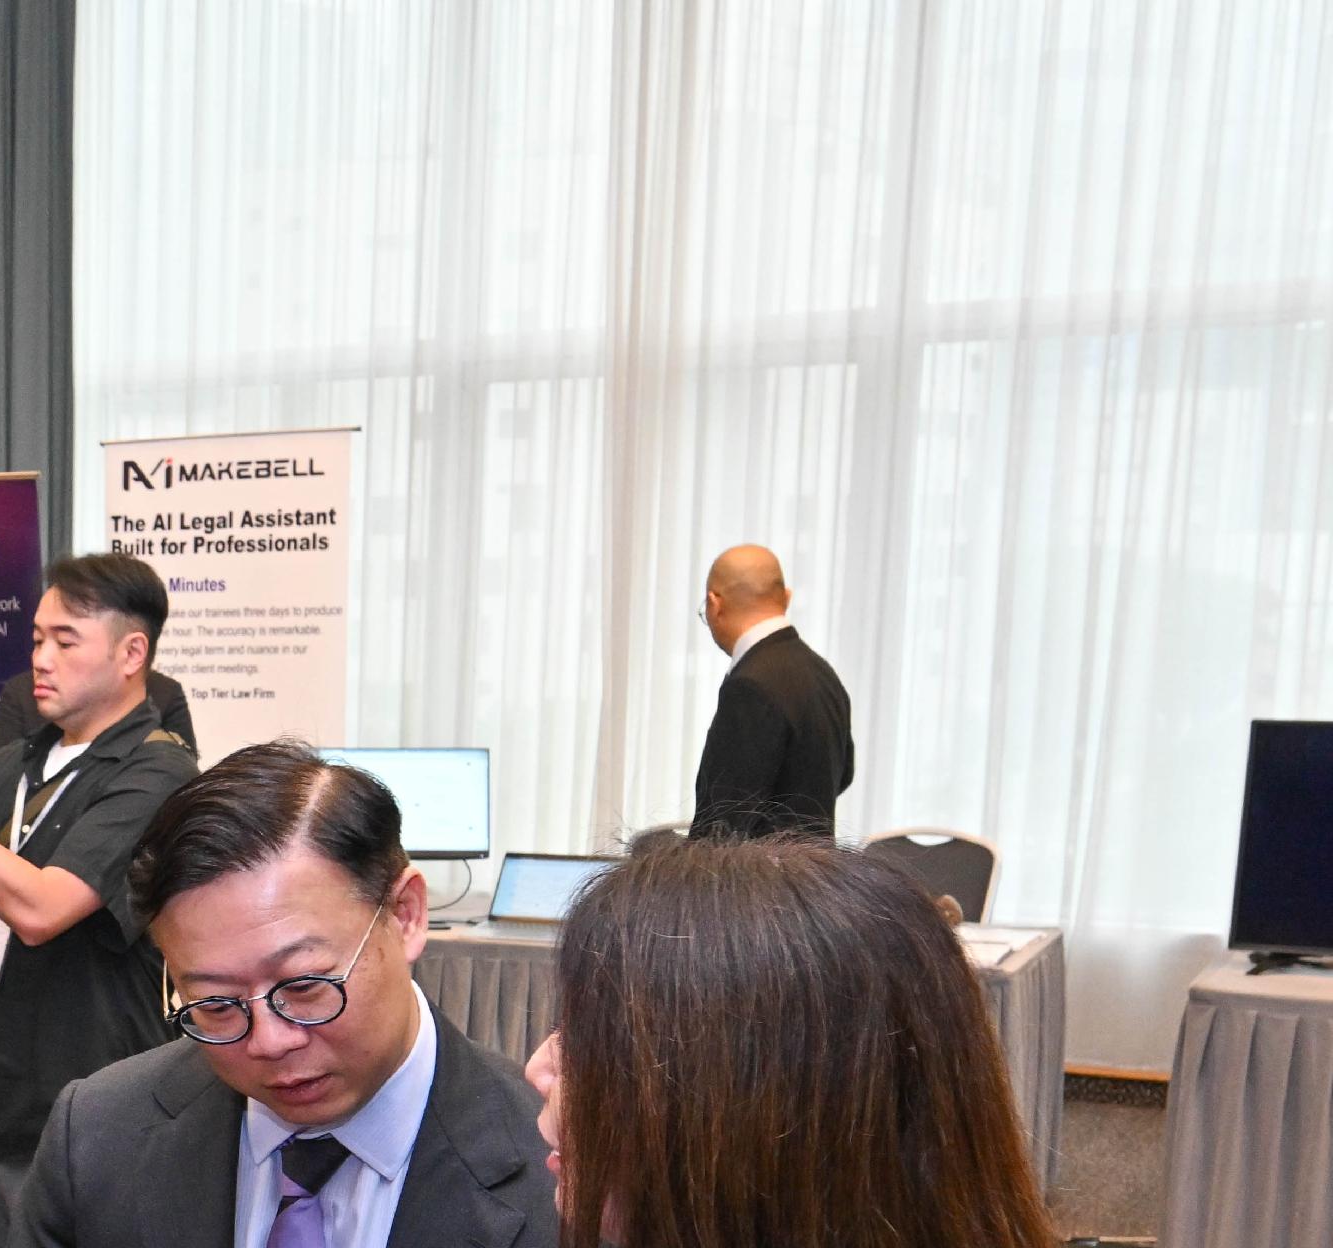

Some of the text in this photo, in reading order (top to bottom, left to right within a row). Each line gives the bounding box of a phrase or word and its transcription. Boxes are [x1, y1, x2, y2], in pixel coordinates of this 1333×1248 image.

[179, 458, 325, 482] MAKEBELL
[111, 508, 337, 534] The AI Legal Assistant
[112, 533, 329, 556] Built for Professionals
[168, 577, 226, 592] Minutes
[205, 607, 241, 618] trainees
[243, 606, 266, 618] three
[269, 605, 290, 619] days
[293, 605, 302, 616] to
[304, 606, 343, 618] produce
[197, 625, 214, 636] The
[216, 626, 256, 638] accuracy
[181, 645, 203, 657] legal
[227, 645, 245, 655] and
[191, 688, 275, 701] Top Tier Law Firm
